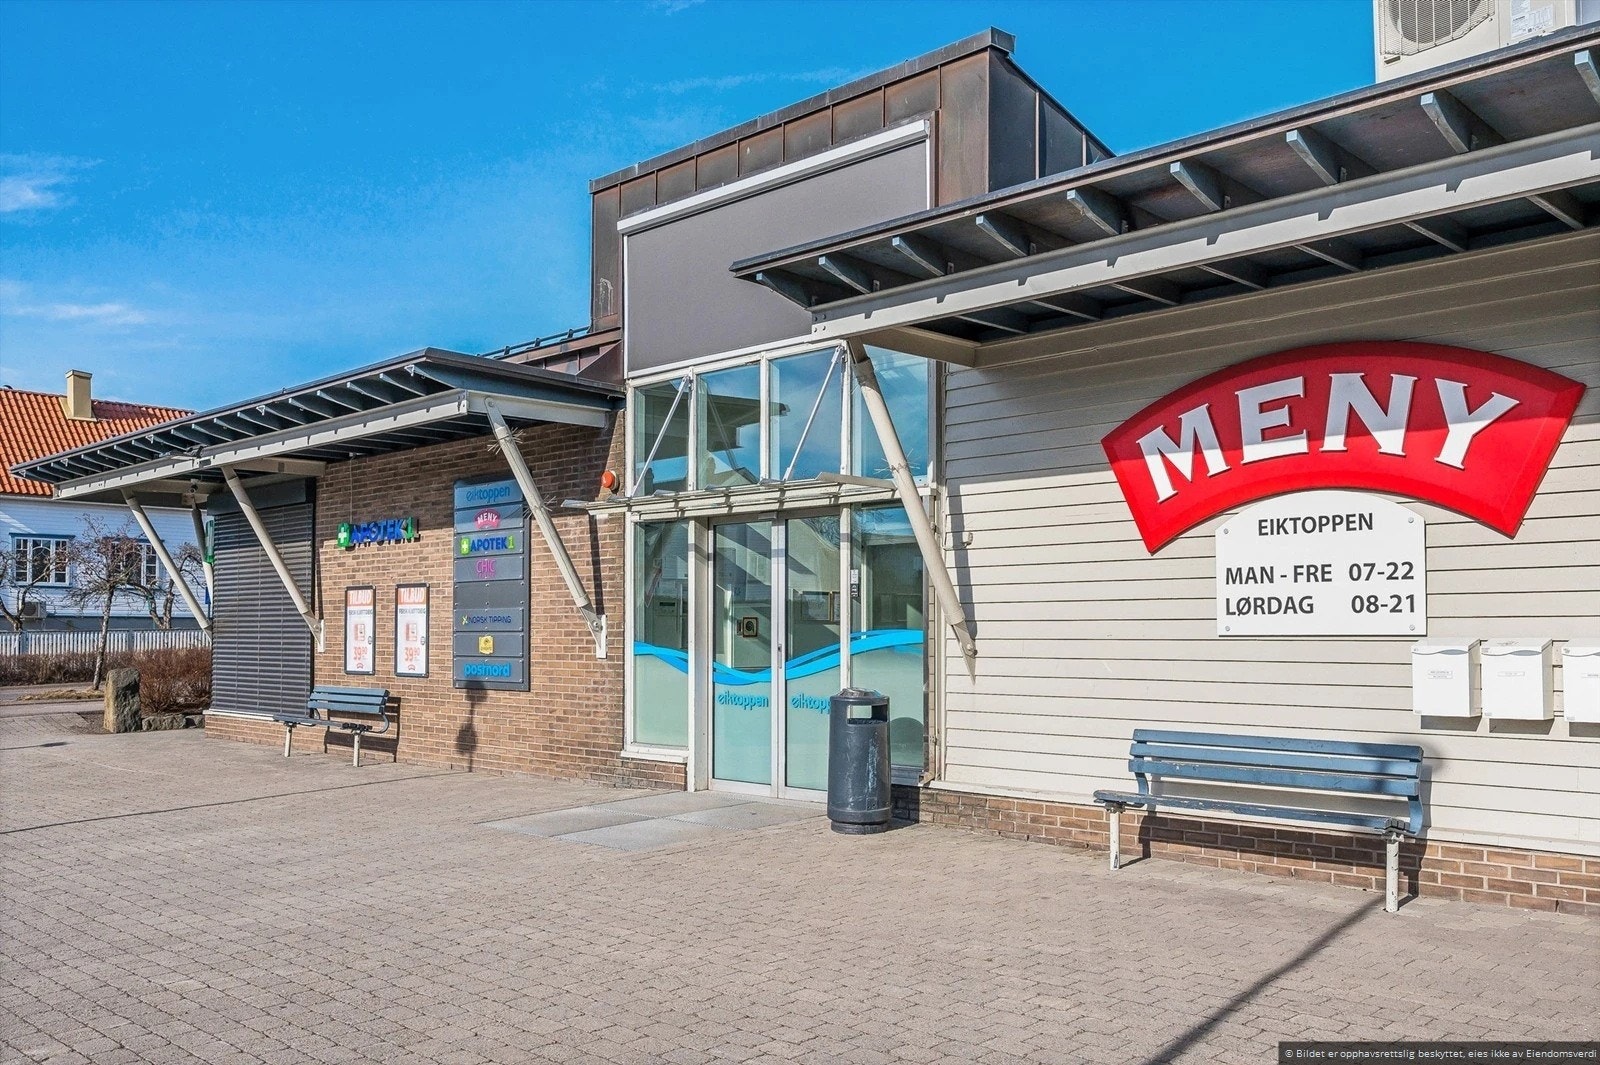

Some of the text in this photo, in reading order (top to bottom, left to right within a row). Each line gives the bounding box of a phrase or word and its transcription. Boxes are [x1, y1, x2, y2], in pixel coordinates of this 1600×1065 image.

[1135, 372, 1521, 504] MENY
[466, 486, 510, 503] eiktoppen
[477, 512, 498, 525] MENY
[1258, 512, 1374, 536] EIKTOPPEN
[1225, 565, 1274, 586] MAN
[1293, 563, 1333, 583] FRE
[1349, 561, 1415, 582] 07-22
[1225, 593, 1417, 617] LØRDAG 08-21
[718, 691, 769, 711] eiktoppen
